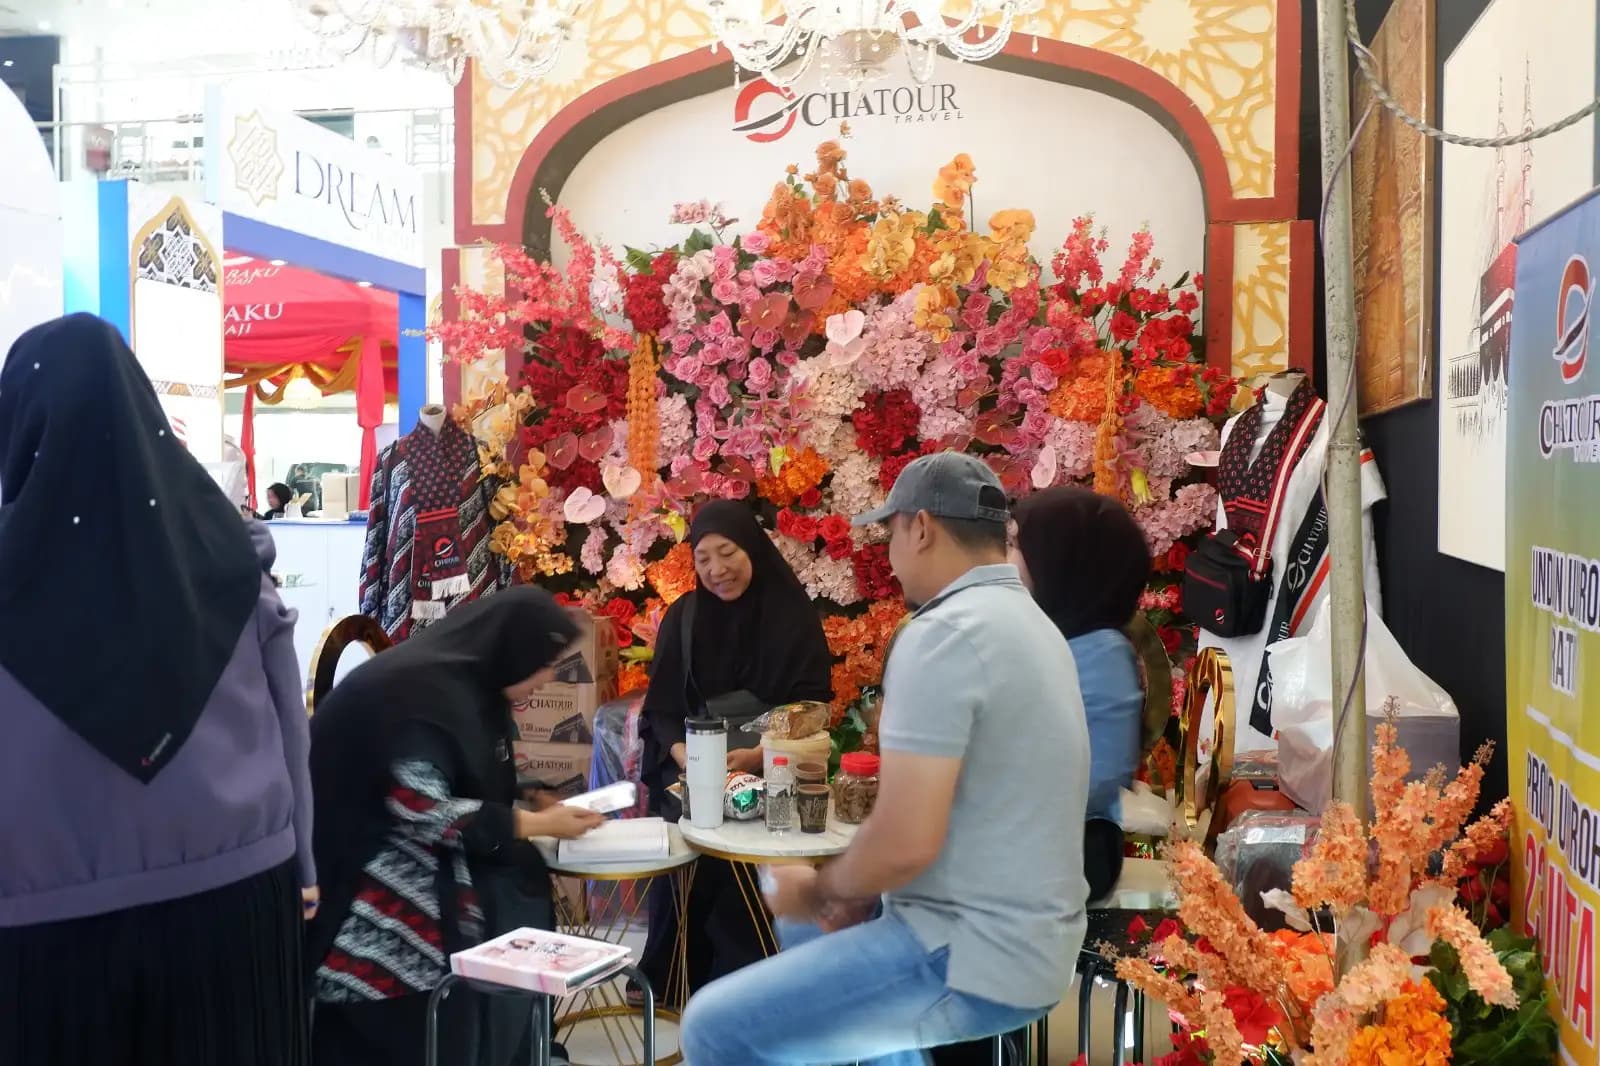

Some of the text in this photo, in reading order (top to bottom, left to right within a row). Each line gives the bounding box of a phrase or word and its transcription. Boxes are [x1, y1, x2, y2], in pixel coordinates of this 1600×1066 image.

[801, 83, 960, 127] CHATOUR
[894, 112, 965, 124] TRAVEL
[295, 149, 417, 234] DREAM
